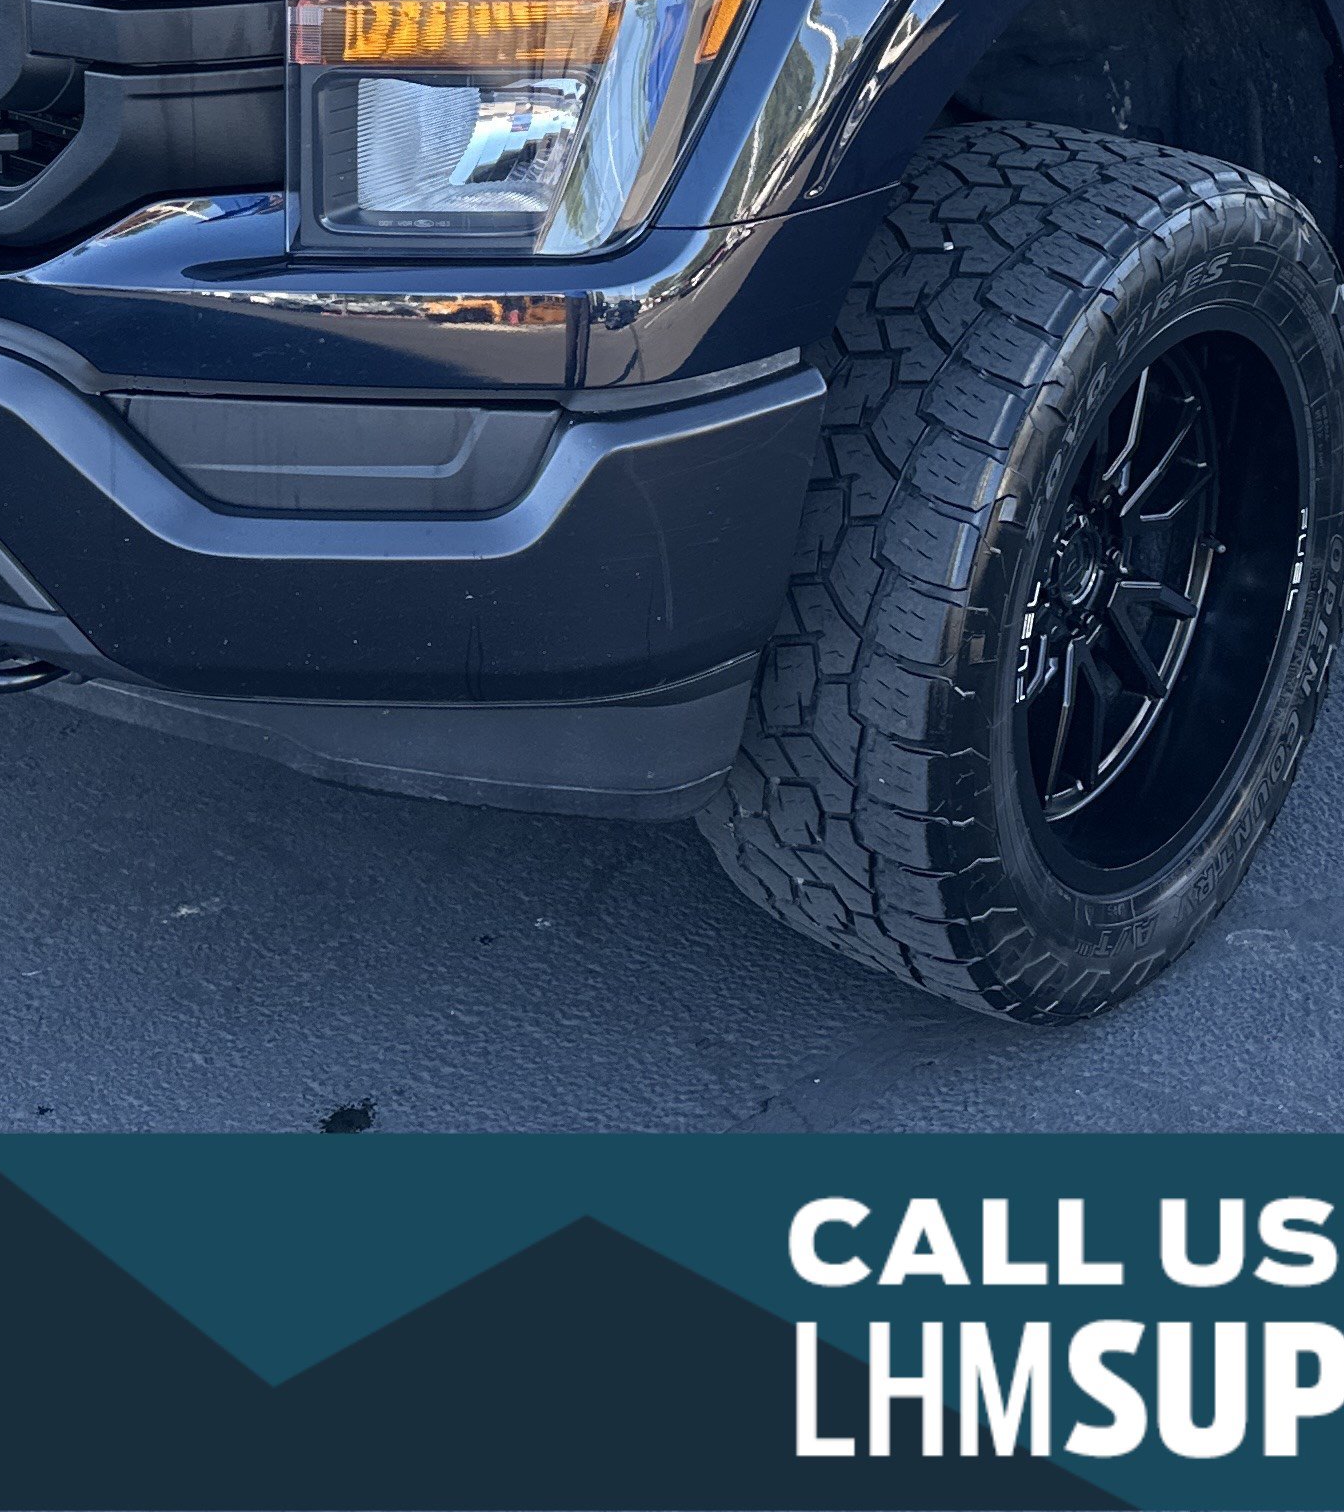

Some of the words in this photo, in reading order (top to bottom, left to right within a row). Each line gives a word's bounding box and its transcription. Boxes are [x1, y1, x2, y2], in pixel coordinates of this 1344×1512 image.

[1116, 251, 1233, 361] TIRES
[1286, 506, 1309, 612] FUEL
[1170, 708, 1304, 928] COUNTRY
